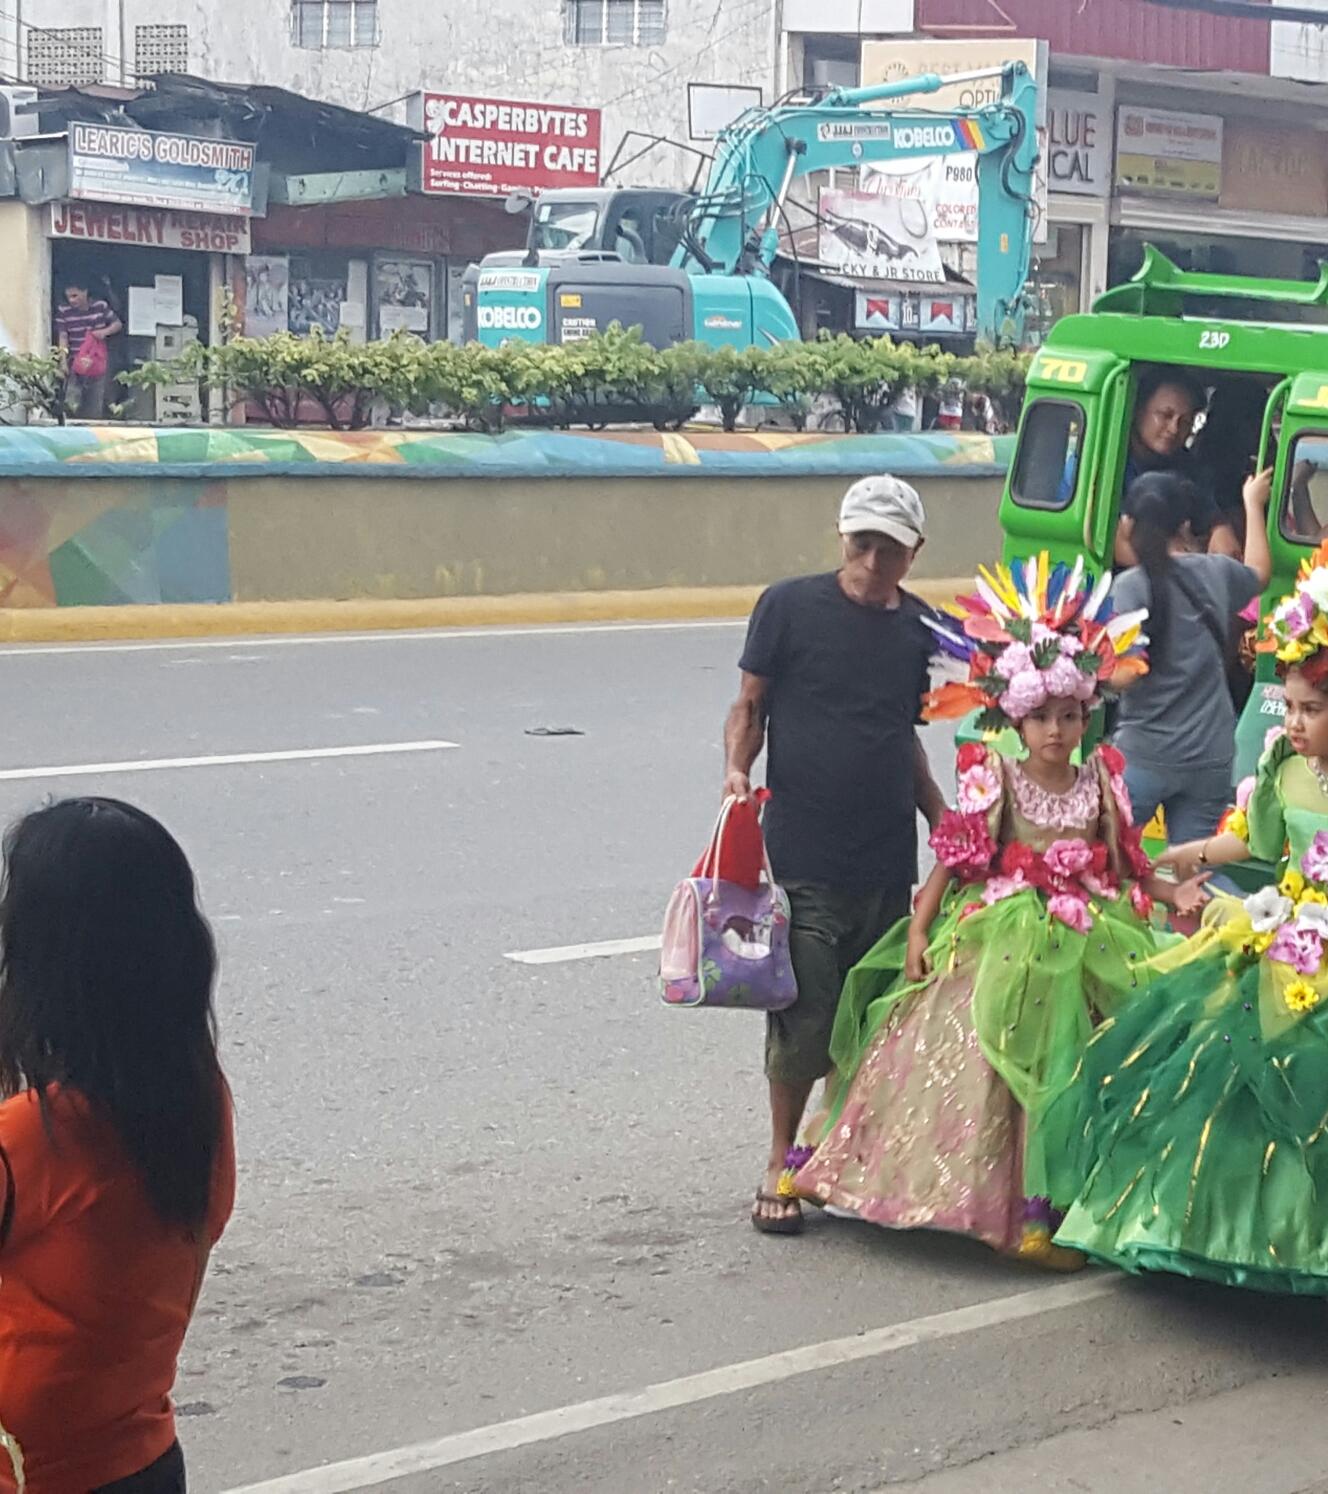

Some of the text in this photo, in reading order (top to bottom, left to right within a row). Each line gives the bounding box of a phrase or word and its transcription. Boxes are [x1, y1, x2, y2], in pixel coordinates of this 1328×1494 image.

[443, 101, 588, 138] CASPERBYTES
[1050, 110, 1097, 149] LUE
[74, 125, 154, 161] LEARIC'S
[153, 138, 254, 172] GOLDSMITH
[893, 126, 955, 149] KOBELCO
[430, 136, 598, 173] INTERNET CAFE
[945, 165, 973, 182] P980
[54, 202, 168, 244] JEWELRY
[180, 229, 240, 251] SHOP
[903, 268, 940, 281] STORE
[478, 305, 542, 329] KOBELCO
